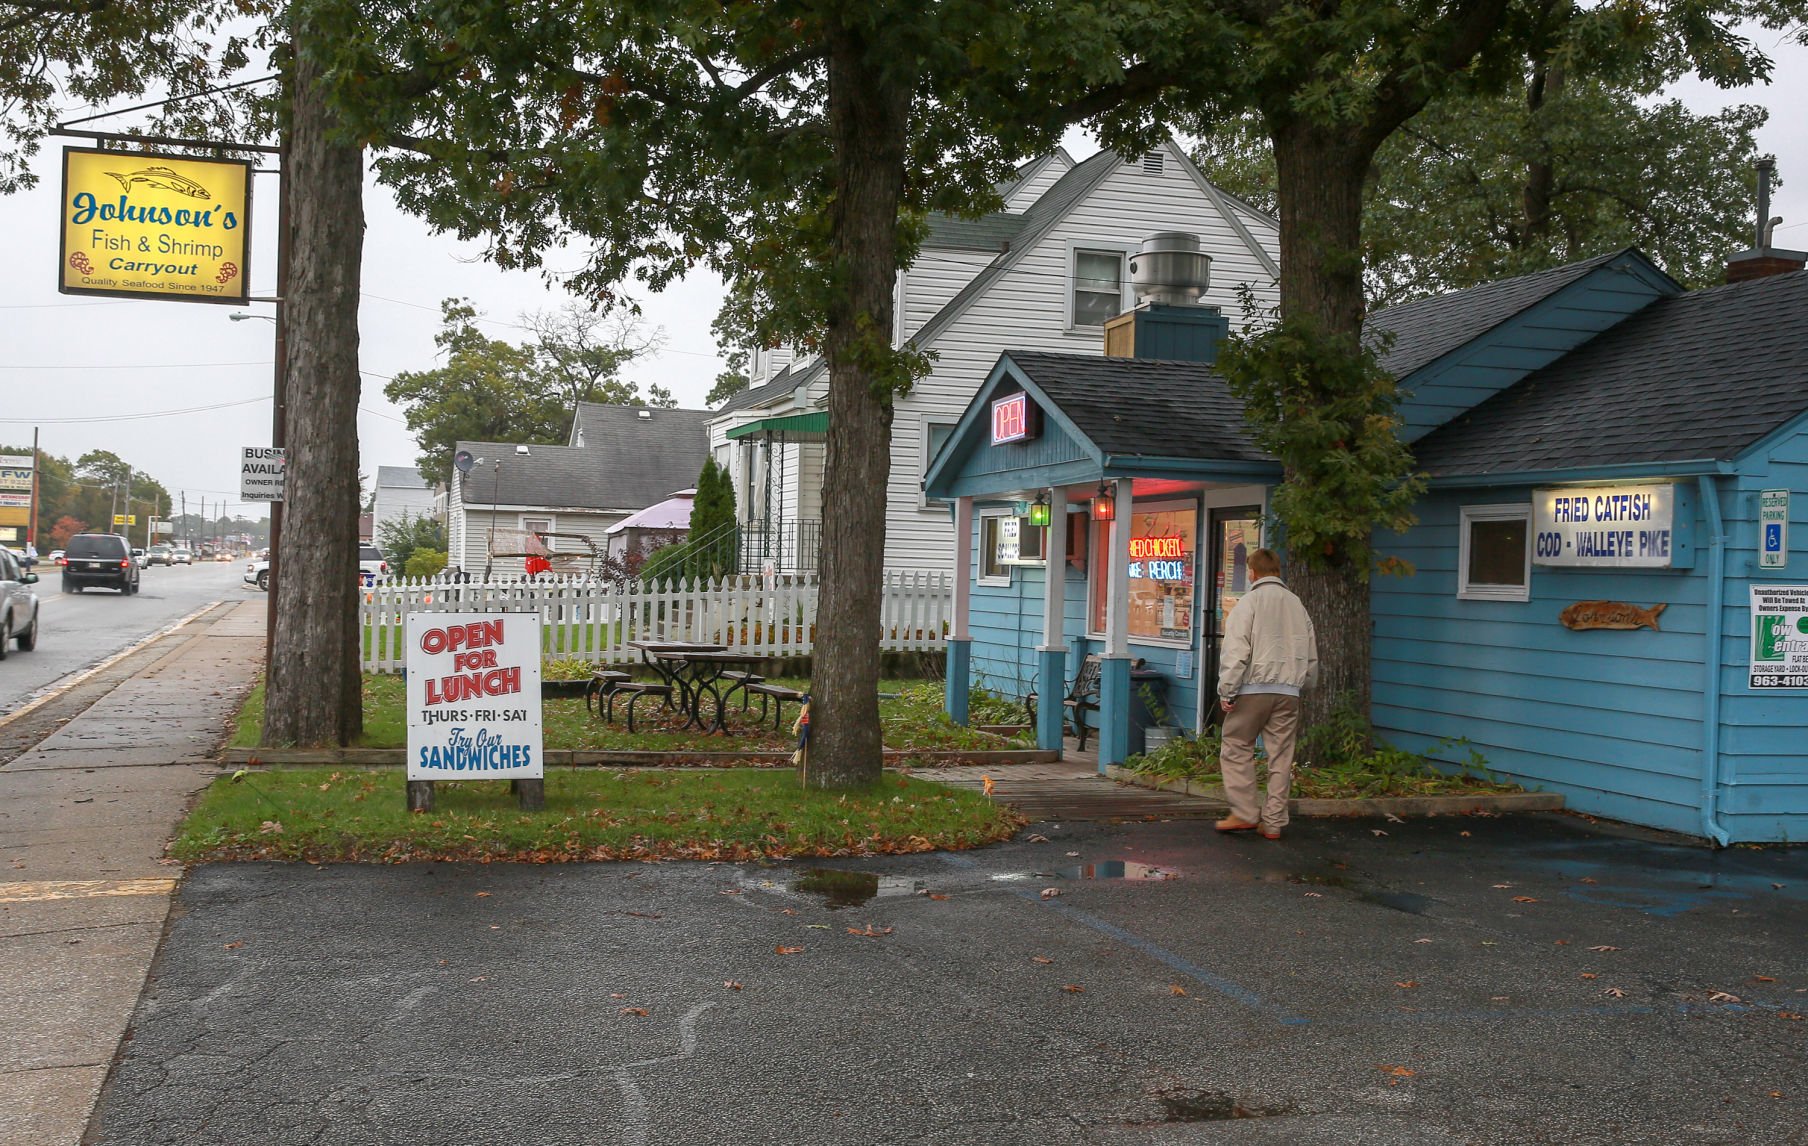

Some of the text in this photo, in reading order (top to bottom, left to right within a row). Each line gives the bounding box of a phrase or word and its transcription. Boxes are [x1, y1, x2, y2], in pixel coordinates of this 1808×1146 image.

[72, 192, 238, 230] Johnson's
[92, 229, 223, 260] Fish & Shrimp
[109, 257, 198, 276] Carryout
[81, 276, 225, 293] Quality Seafood Since 1947
[994, 400, 1025, 440] OPEN
[1555, 494, 1651, 522] FRIED CATFISH
[1762, 497, 1787, 507] RESERVED
[1763, 510, 1785, 520] PARKING
[1145, 538, 1182, 557] CHICKEN
[1537, 530, 1670, 557] COD WALLEYE PIKE
[1766, 553, 1780, 564] ONLY
[1149, 561, 1183, 580] PERCH
[1780, 605, 1800, 613] Expense
[420, 619, 504, 655] OPEN
[454, 649, 498, 672] FOR
[425, 667, 520, 706] LUNCH
[448, 727, 502, 749] Try Our
[420, 745, 530, 771] SANDWICHES
